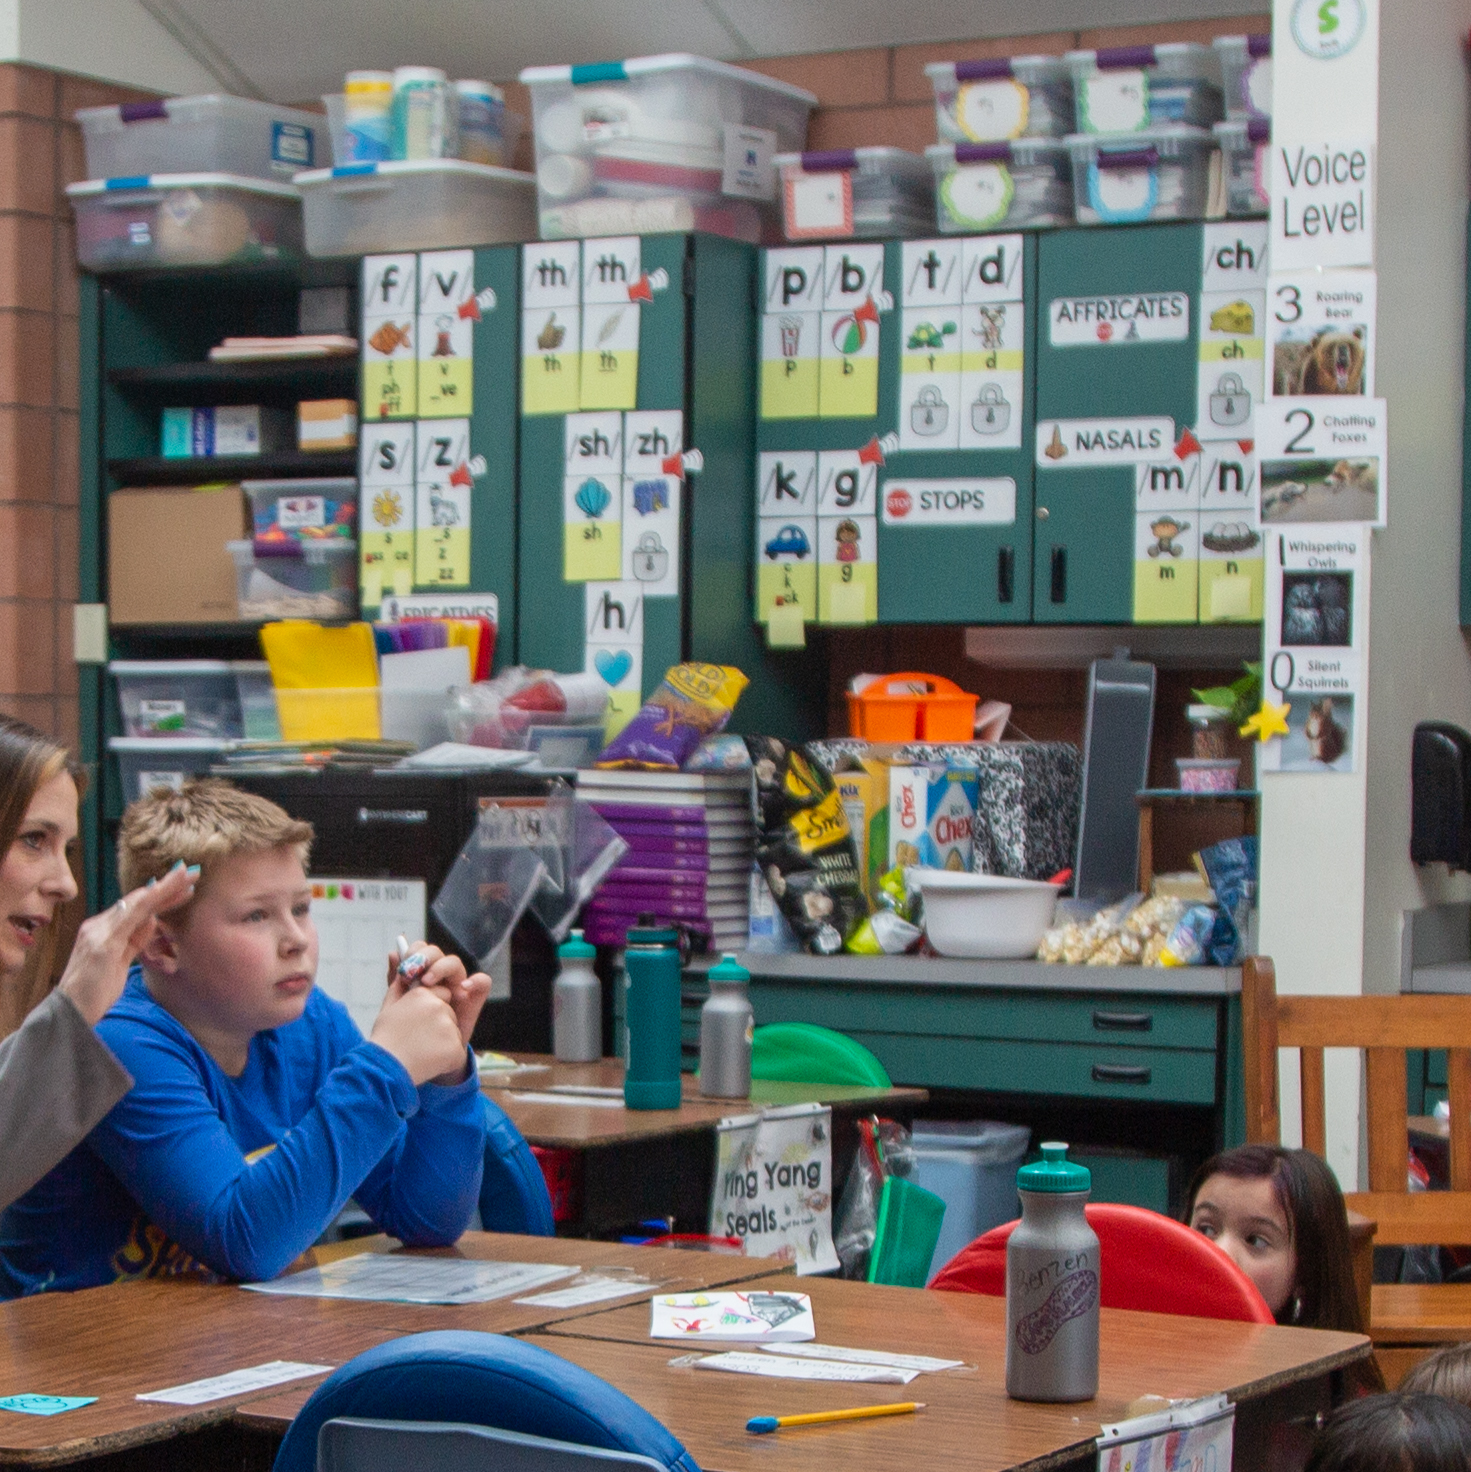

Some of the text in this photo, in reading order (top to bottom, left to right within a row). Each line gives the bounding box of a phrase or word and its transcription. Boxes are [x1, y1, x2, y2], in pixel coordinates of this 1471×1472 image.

[1282, 144, 1366, 188] Voice
[1283, 189, 1365, 238] Level
[1056, 297, 1184, 325] AFFRICATES
[1275, 284, 1364, 324] 3 Roaring
[1325, 307, 1353, 319] Bear
[1221, 341, 1245, 360] ch
[543, 354, 562, 373] th
[784, 360, 797, 379] p
[842, 356, 855, 376] b
[985, 351, 998, 370] d
[1075, 429, 1163, 453] NASALS
[1283, 409, 1377, 454] 2 Chatting
[1332, 430, 1368, 444] Foxes
[920, 490, 986, 511] STOPS
[583, 523, 603, 542] sh
[1288, 540, 1357, 558] Whispering
[1226, 561, 1239, 576] n
[1307, 555, 1338, 569] Owls
[841, 565, 854, 585] g
[1158, 565, 1176, 581] m
[1307, 660, 1342, 674] Silent
[1297, 675, 1350, 692] Squirrels
[839, 782, 861, 797] Kix
[901, 784, 917, 829] Chex
[936, 815, 974, 846] Chex
[764, 1161, 822, 1190] Yang
[725, 1204, 778, 1237] Seals
